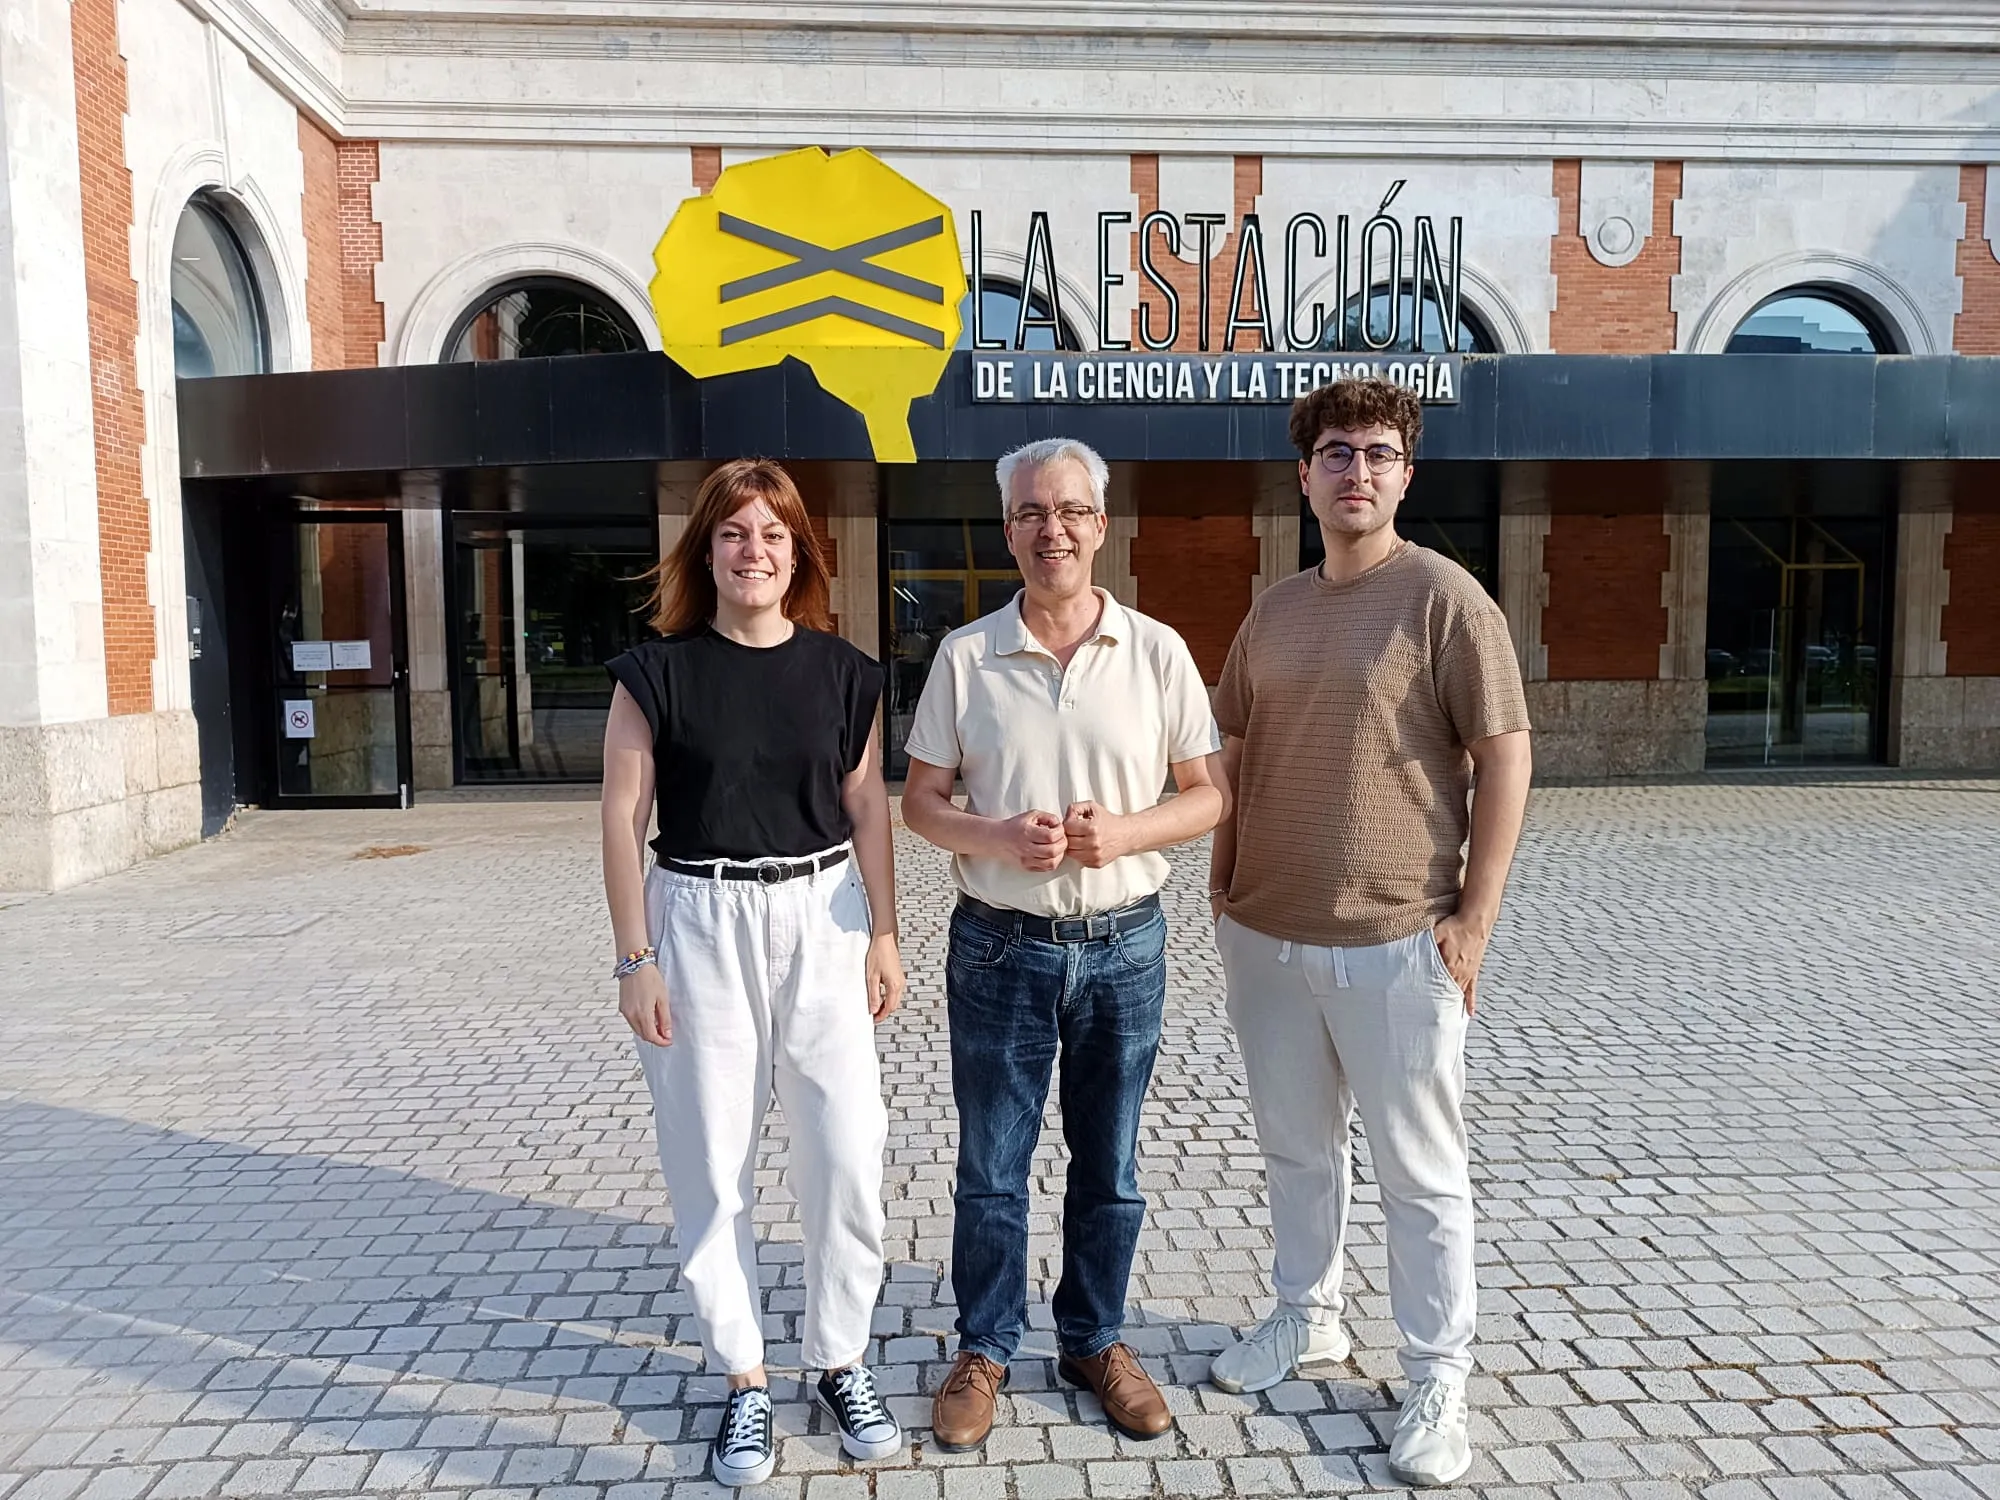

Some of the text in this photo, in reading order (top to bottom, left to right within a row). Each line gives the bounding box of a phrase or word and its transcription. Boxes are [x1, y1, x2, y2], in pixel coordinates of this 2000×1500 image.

[971, 180, 1462, 352] LA ESTACIÓN
[976, 361, 1014, 398] DE
[1033, 361, 1068, 398] LA
[1077, 361, 1194, 399] CIENCIA
[1203, 361, 1222, 398] Y
[1231, 361, 1267, 398] LA
